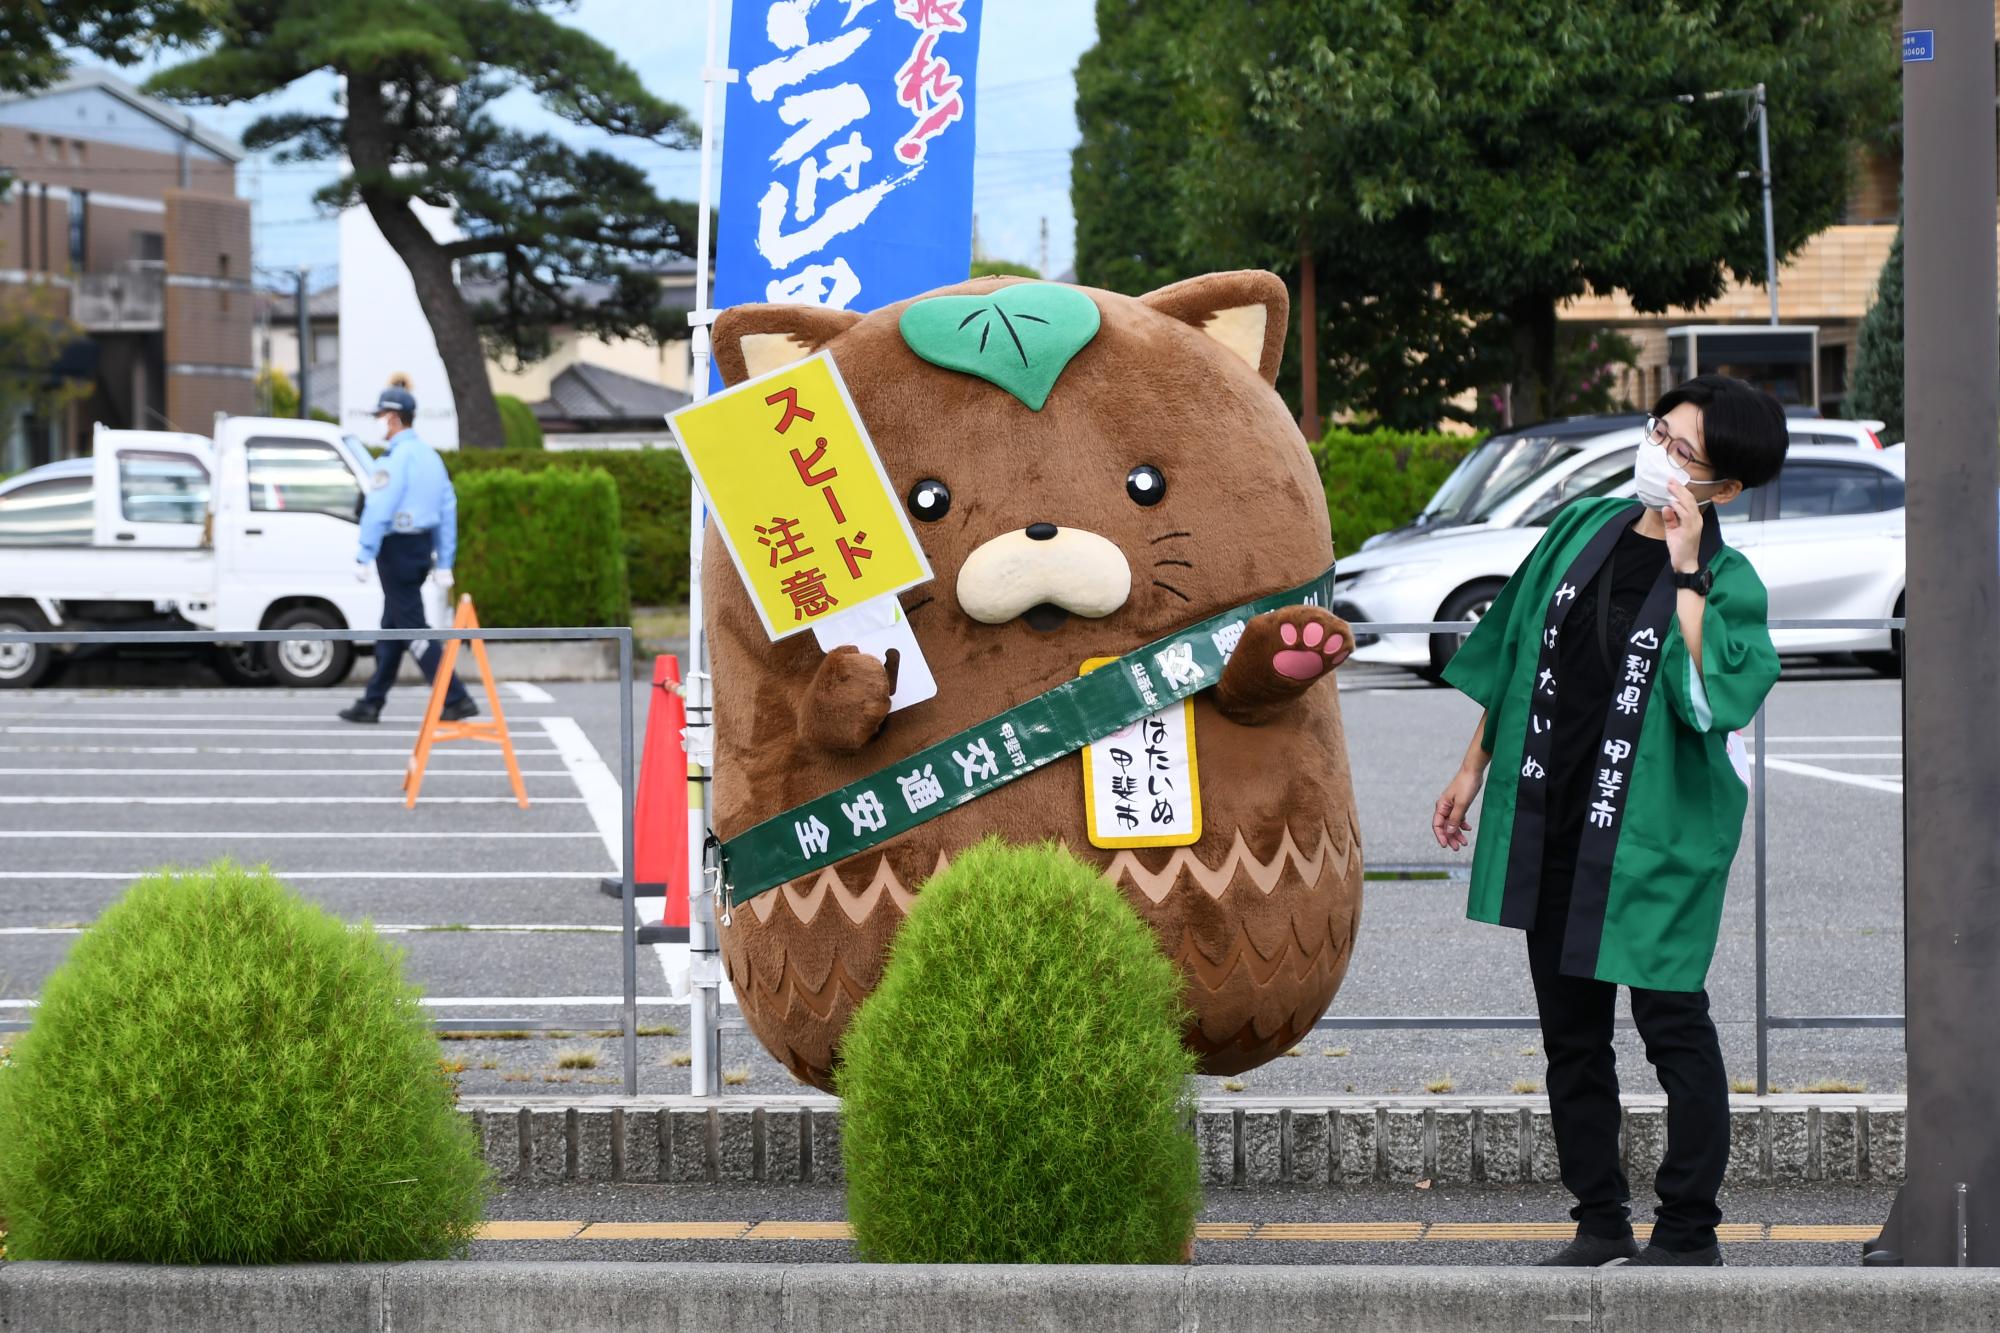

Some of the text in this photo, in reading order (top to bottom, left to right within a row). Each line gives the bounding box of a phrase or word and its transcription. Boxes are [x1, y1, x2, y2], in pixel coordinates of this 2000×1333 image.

[765, 386, 873, 580] スピード
[754, 516, 839, 621] 注意
[1521, 582, 1576, 780] やはたいぬ
[1589, 627, 1659, 829] 山梨県 甲斐市
[794, 737, 999, 860] 交通安全
[1000, 722, 1027, 767] 甲斐市
[1109, 747, 1141, 831] 甲斐市
[1143, 711, 1176, 825] はたいぬ
